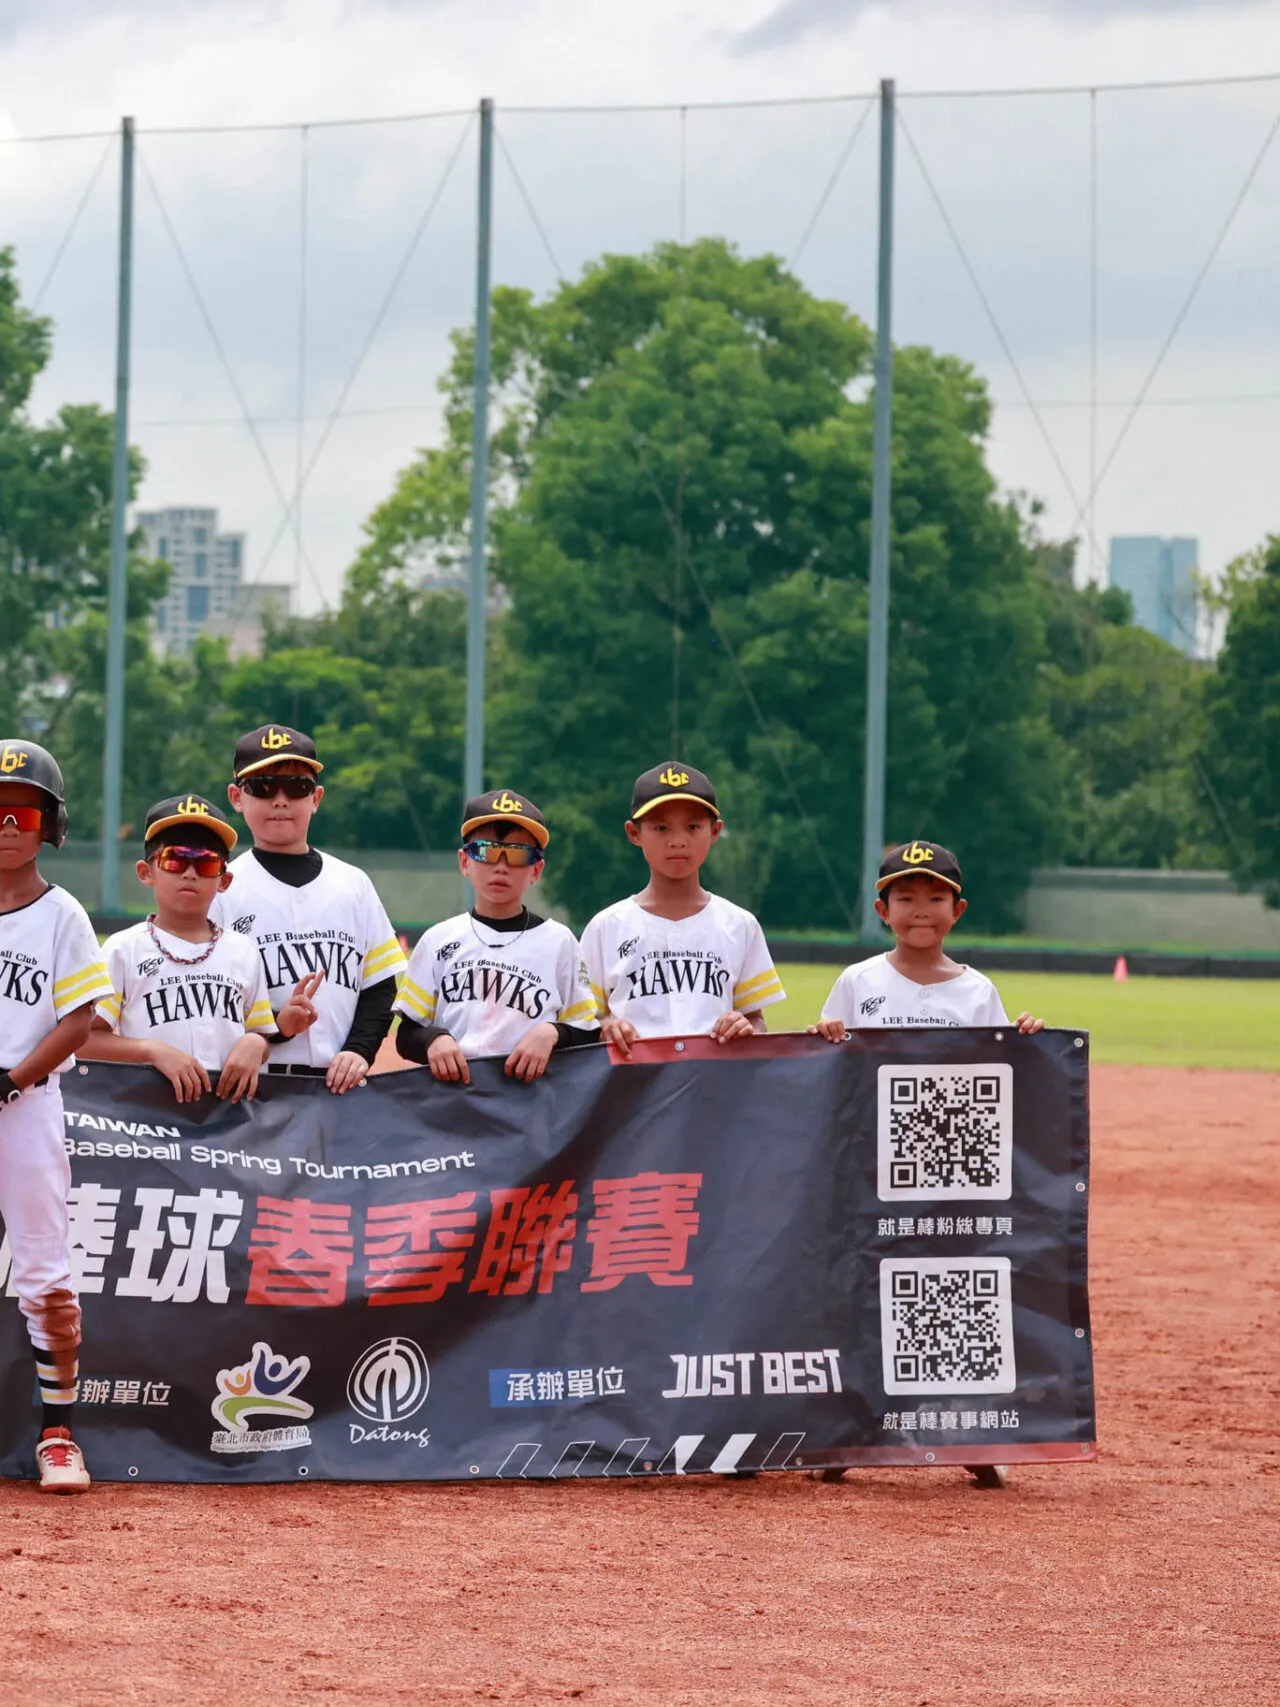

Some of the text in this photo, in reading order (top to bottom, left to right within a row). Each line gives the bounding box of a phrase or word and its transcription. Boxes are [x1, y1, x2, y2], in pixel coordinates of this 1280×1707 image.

[256, 930, 356, 945] LEE Baseball Clu
[15, 953, 38, 966] Club
[662, 950, 703, 959] Baseball
[160, 975, 182, 987] LEE
[185, 973, 224, 983] Baseball
[477, 959, 519, 973] Baseball
[521, 969, 542, 984] Club
[441, 967, 551, 1020] HAWKS
[881, 1016, 904, 1025] LEE
[907, 1016, 946, 1025] Baseball
[63, 1111, 181, 1138] TAIWAN
[190, 1147, 282, 1175] Spring
[289, 1149, 476, 1180] Tournament
[877, 1216, 1014, 1237] 就是棒粉絲專頁
[506, 1366, 626, 1402] 承辦單位
[661, 1349, 841, 1399] JUST BEST
[75, 1378, 172, 1406] 辦單位
[882, 1410, 1019, 1431] 就是棒賽事網站
[349, 1423, 431, 1448] Datong
